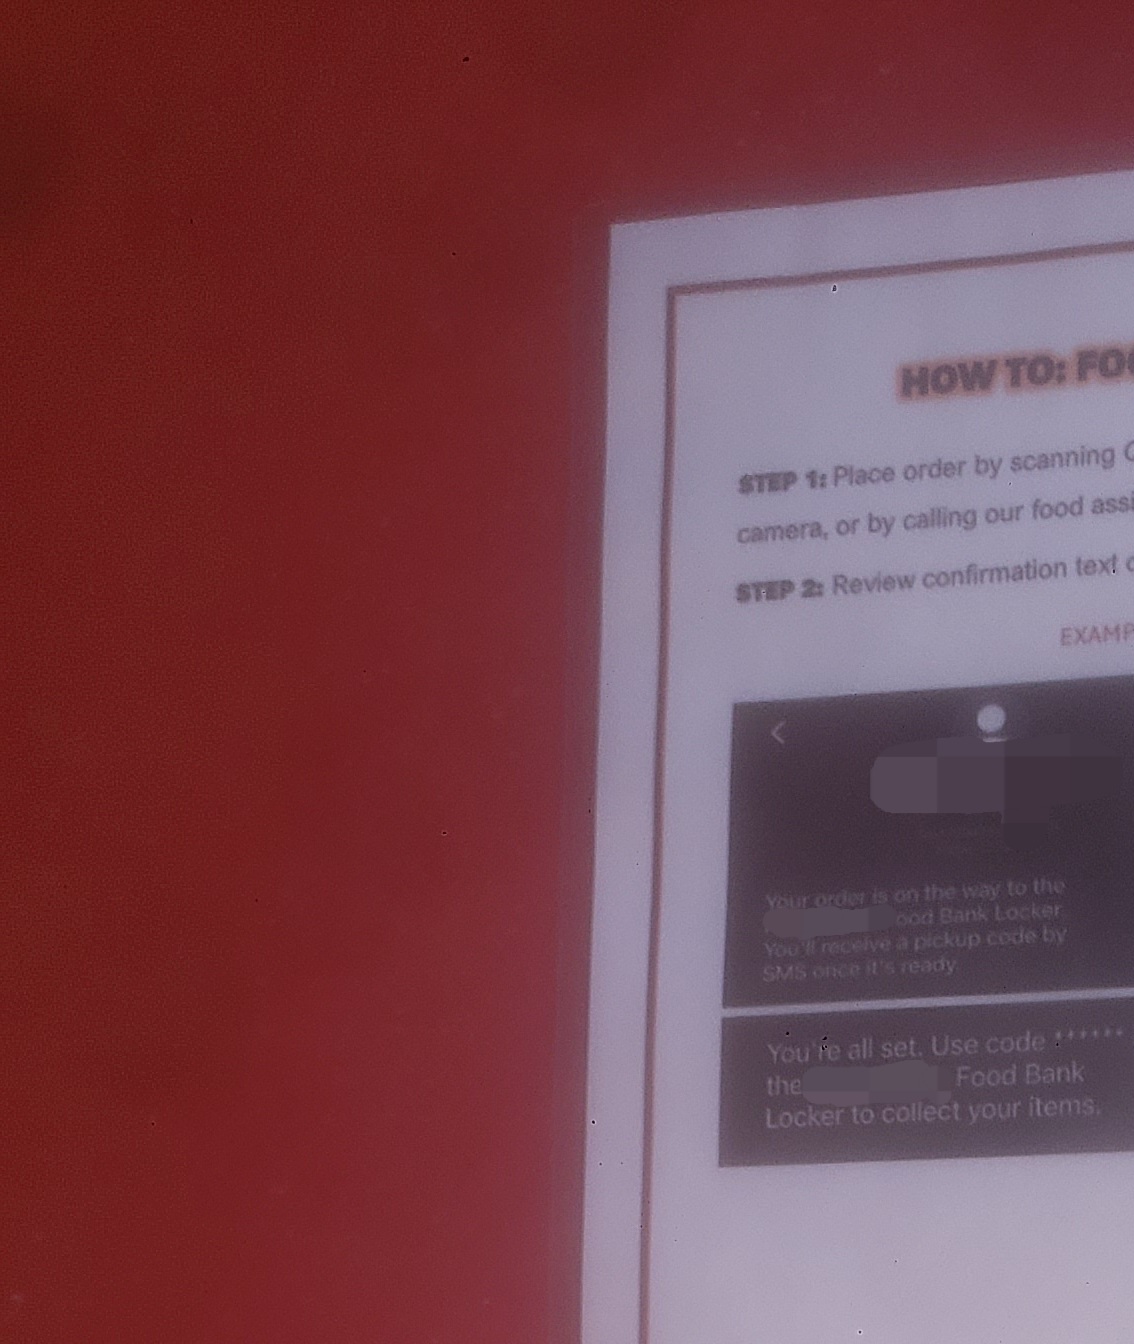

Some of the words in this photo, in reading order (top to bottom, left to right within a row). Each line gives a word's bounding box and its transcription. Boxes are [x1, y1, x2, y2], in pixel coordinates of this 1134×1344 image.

[900, 358, 1000, 398] HOW
[1003, 354, 1067, 388] TO:
[738, 470, 798, 495] STEP
[805, 469, 828, 490] 1:
[832, 464, 896, 487] Place
[902, 457, 967, 483] order
[973, 454, 1003, 480] by
[1009, 445, 1116, 474] scanning
[736, 520, 829, 545] camera,
[834, 517, 860, 537] or
[867, 512, 896, 538] by
[902, 506, 978, 532] calling
[983, 504, 1024, 525] our
[1031, 495, 1085, 520] food
[735, 579, 796, 604] STEP
[801, 578, 824, 599] 2:
[831, 572, 916, 596] Review
[921, 558, 1068, 590] confirmation
[1074, 554, 1119, 577] text
[896, 908, 934, 926] ood
[767, 1042, 841, 1064] You're
[847, 1038, 873, 1061] all
[881, 1038, 922, 1059] set.
[931, 1035, 979, 1057] Use
[984, 1030, 1046, 1055] code
[766, 1075, 805, 1097] the
[955, 1064, 1017, 1088] Food
[1024, 1061, 1084, 1086] Bank
[765, 1106, 844, 1130] Locker
[847, 1100, 876, 1125] to
[881, 1095, 960, 1125] collect
[968, 1101, 1022, 1126] your
[1028, 1097, 1103, 1120] items.
